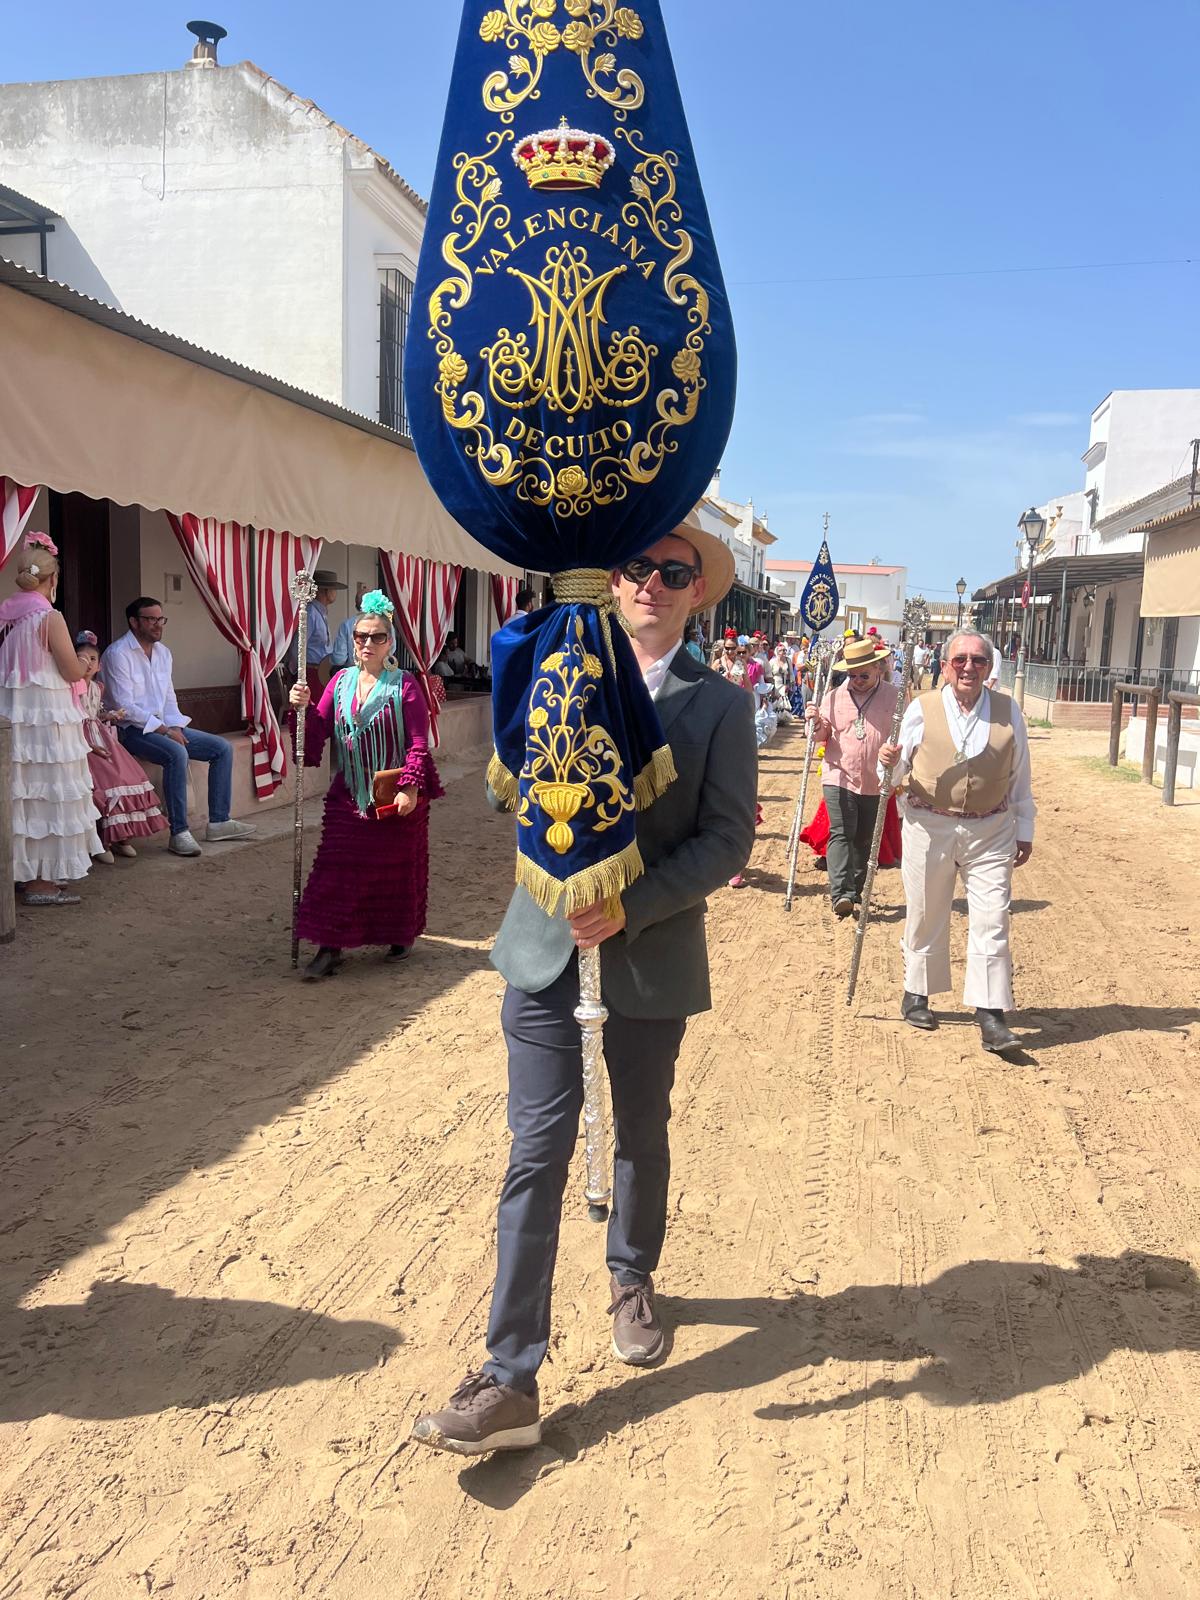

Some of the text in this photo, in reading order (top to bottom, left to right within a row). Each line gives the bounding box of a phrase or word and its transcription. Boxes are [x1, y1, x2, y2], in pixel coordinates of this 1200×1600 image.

[475, 206, 656, 280] VALENCIANA
[504, 416, 632, 458] DE CULTO
